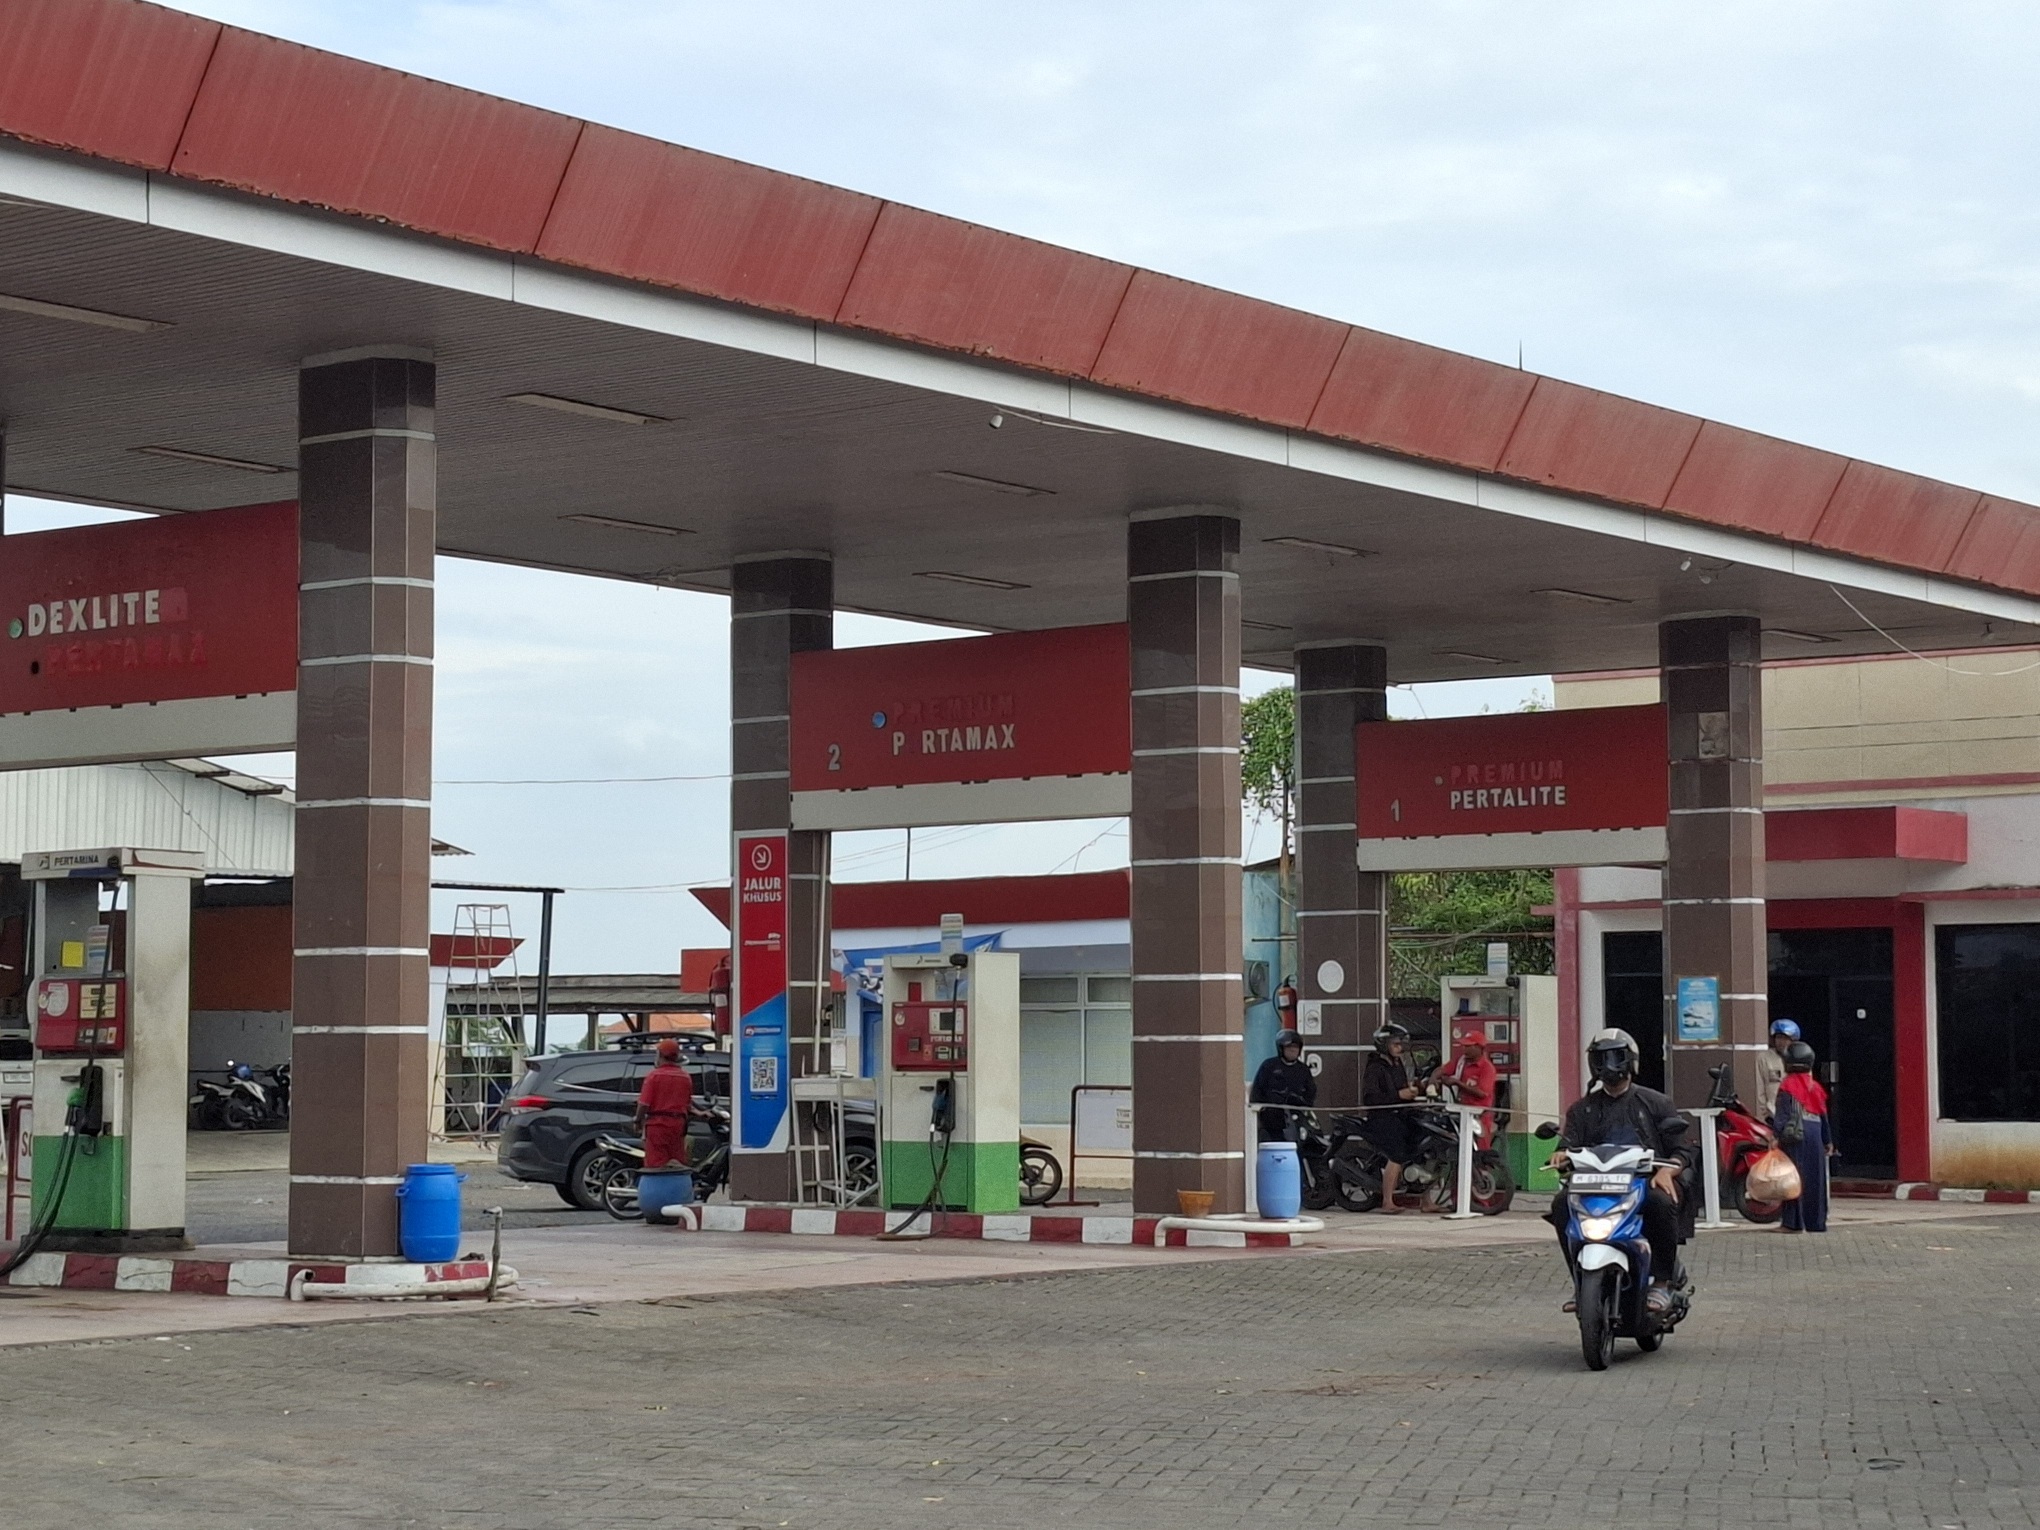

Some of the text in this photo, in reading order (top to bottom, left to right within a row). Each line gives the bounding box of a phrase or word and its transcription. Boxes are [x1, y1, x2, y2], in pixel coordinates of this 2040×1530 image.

[27, 588, 160, 637] DEXLITE
[892, 723, 1016, 756] PRTAMAX
[827, 744, 841, 771] 2
[1450, 759, 1564, 785] PREMIUM
[1450, 785, 1567, 810] PERTALITE
[1390, 799, 1401, 822] 1
[54, 855, 99, 867] PERTAMINA
[744, 876, 782, 891] JALUR
[743, 891, 782, 903] KHUSUS
